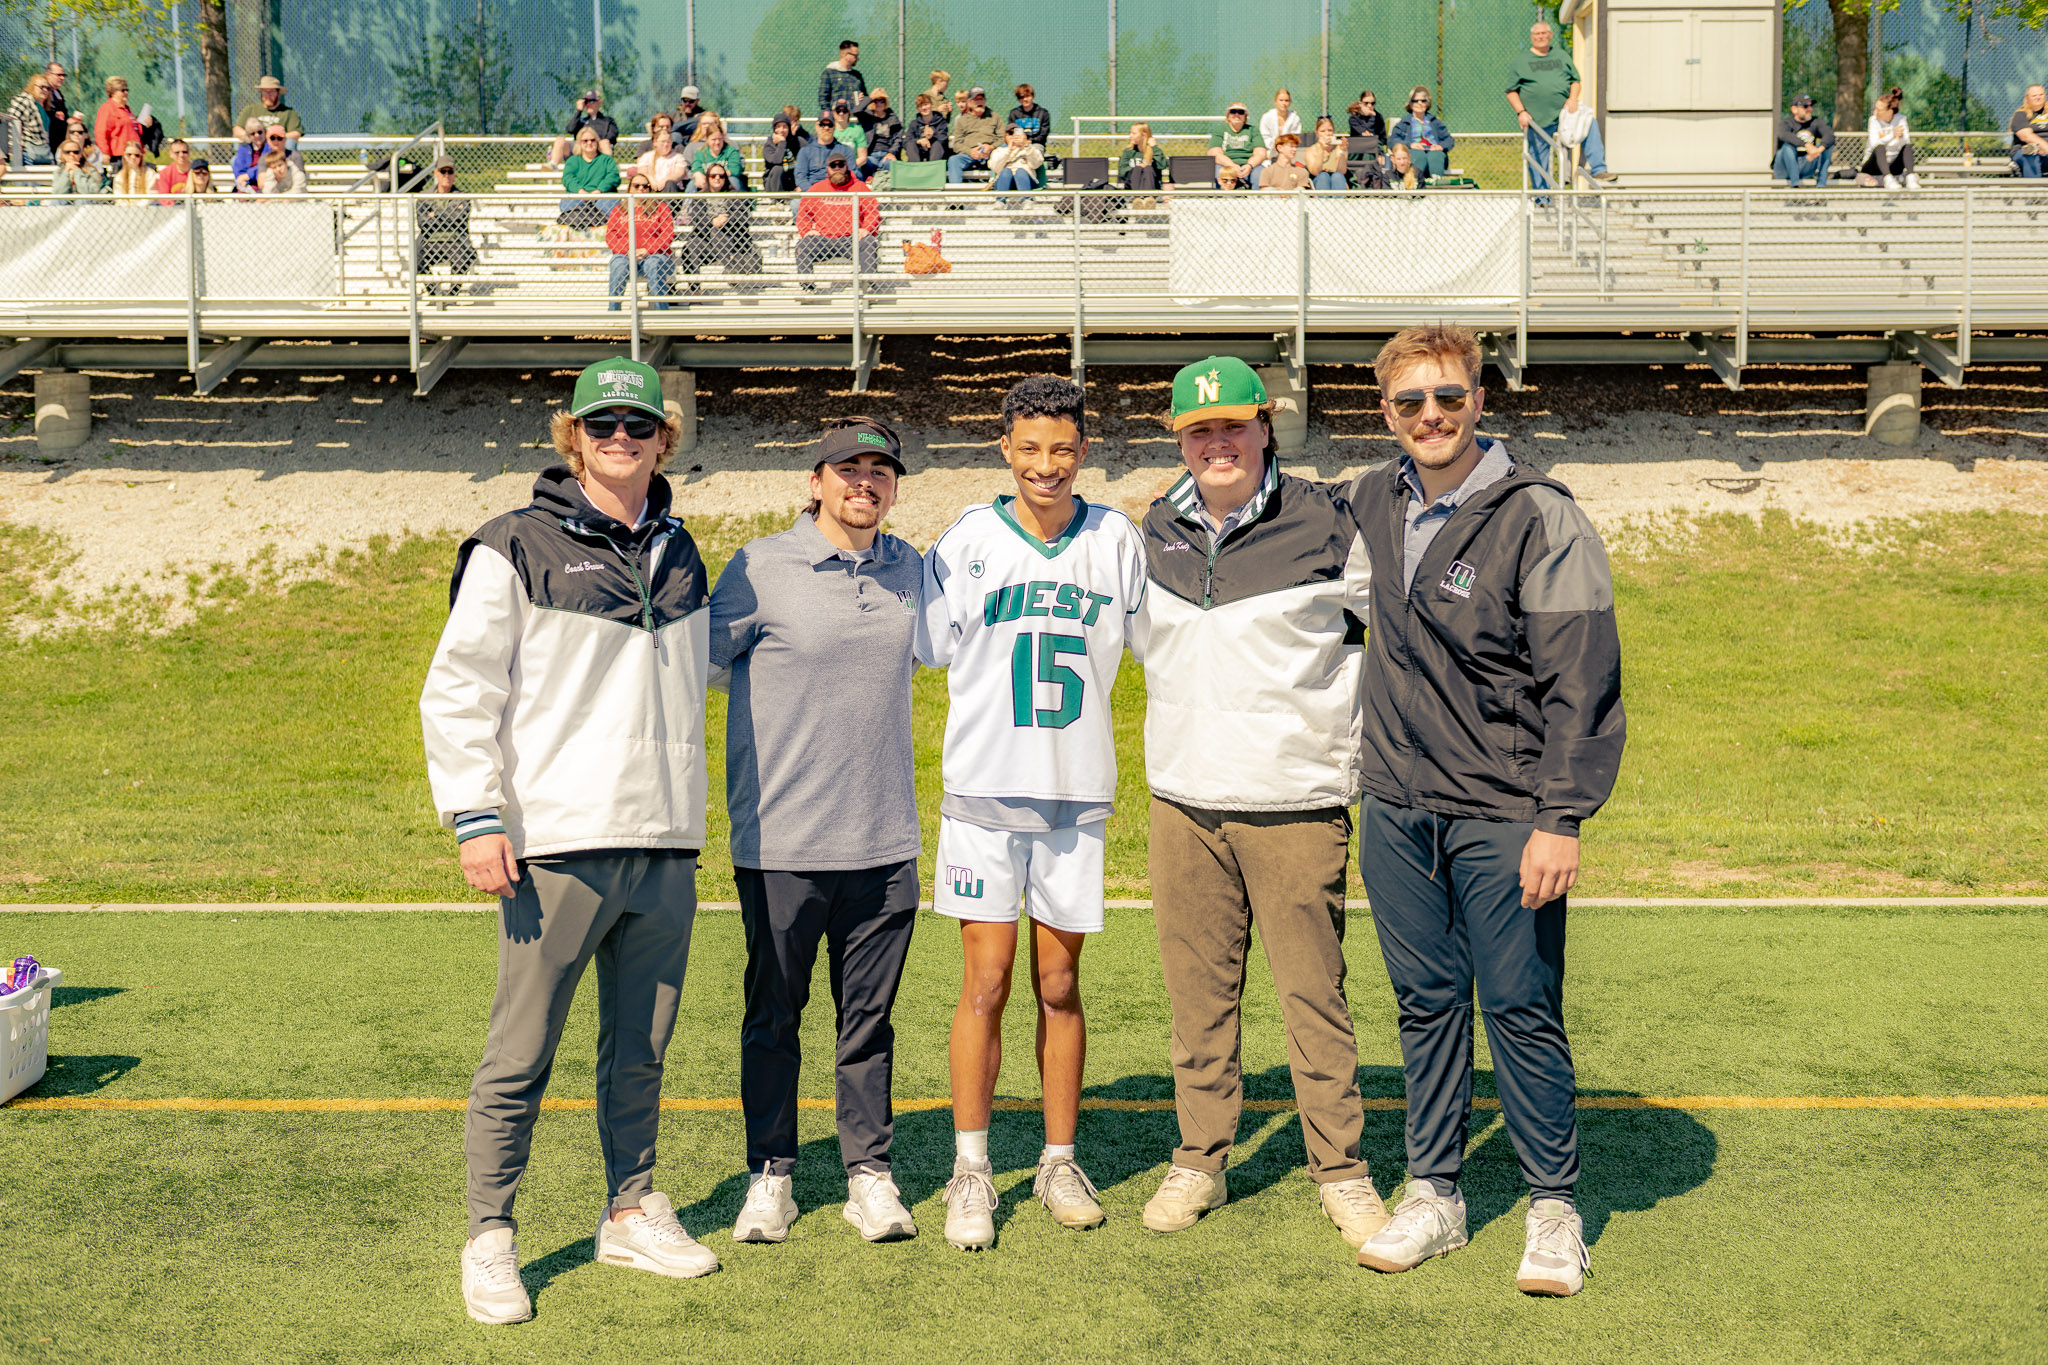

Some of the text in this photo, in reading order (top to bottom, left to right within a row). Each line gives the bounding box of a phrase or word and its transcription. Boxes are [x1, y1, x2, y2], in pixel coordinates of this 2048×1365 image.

[597, 372, 644, 389] WILDCATS
[1195, 375, 1222, 404] N
[602, 391, 639, 400] LACROSSE
[984, 581, 1113, 627] WEST
[1011, 632, 1088, 729] 15
